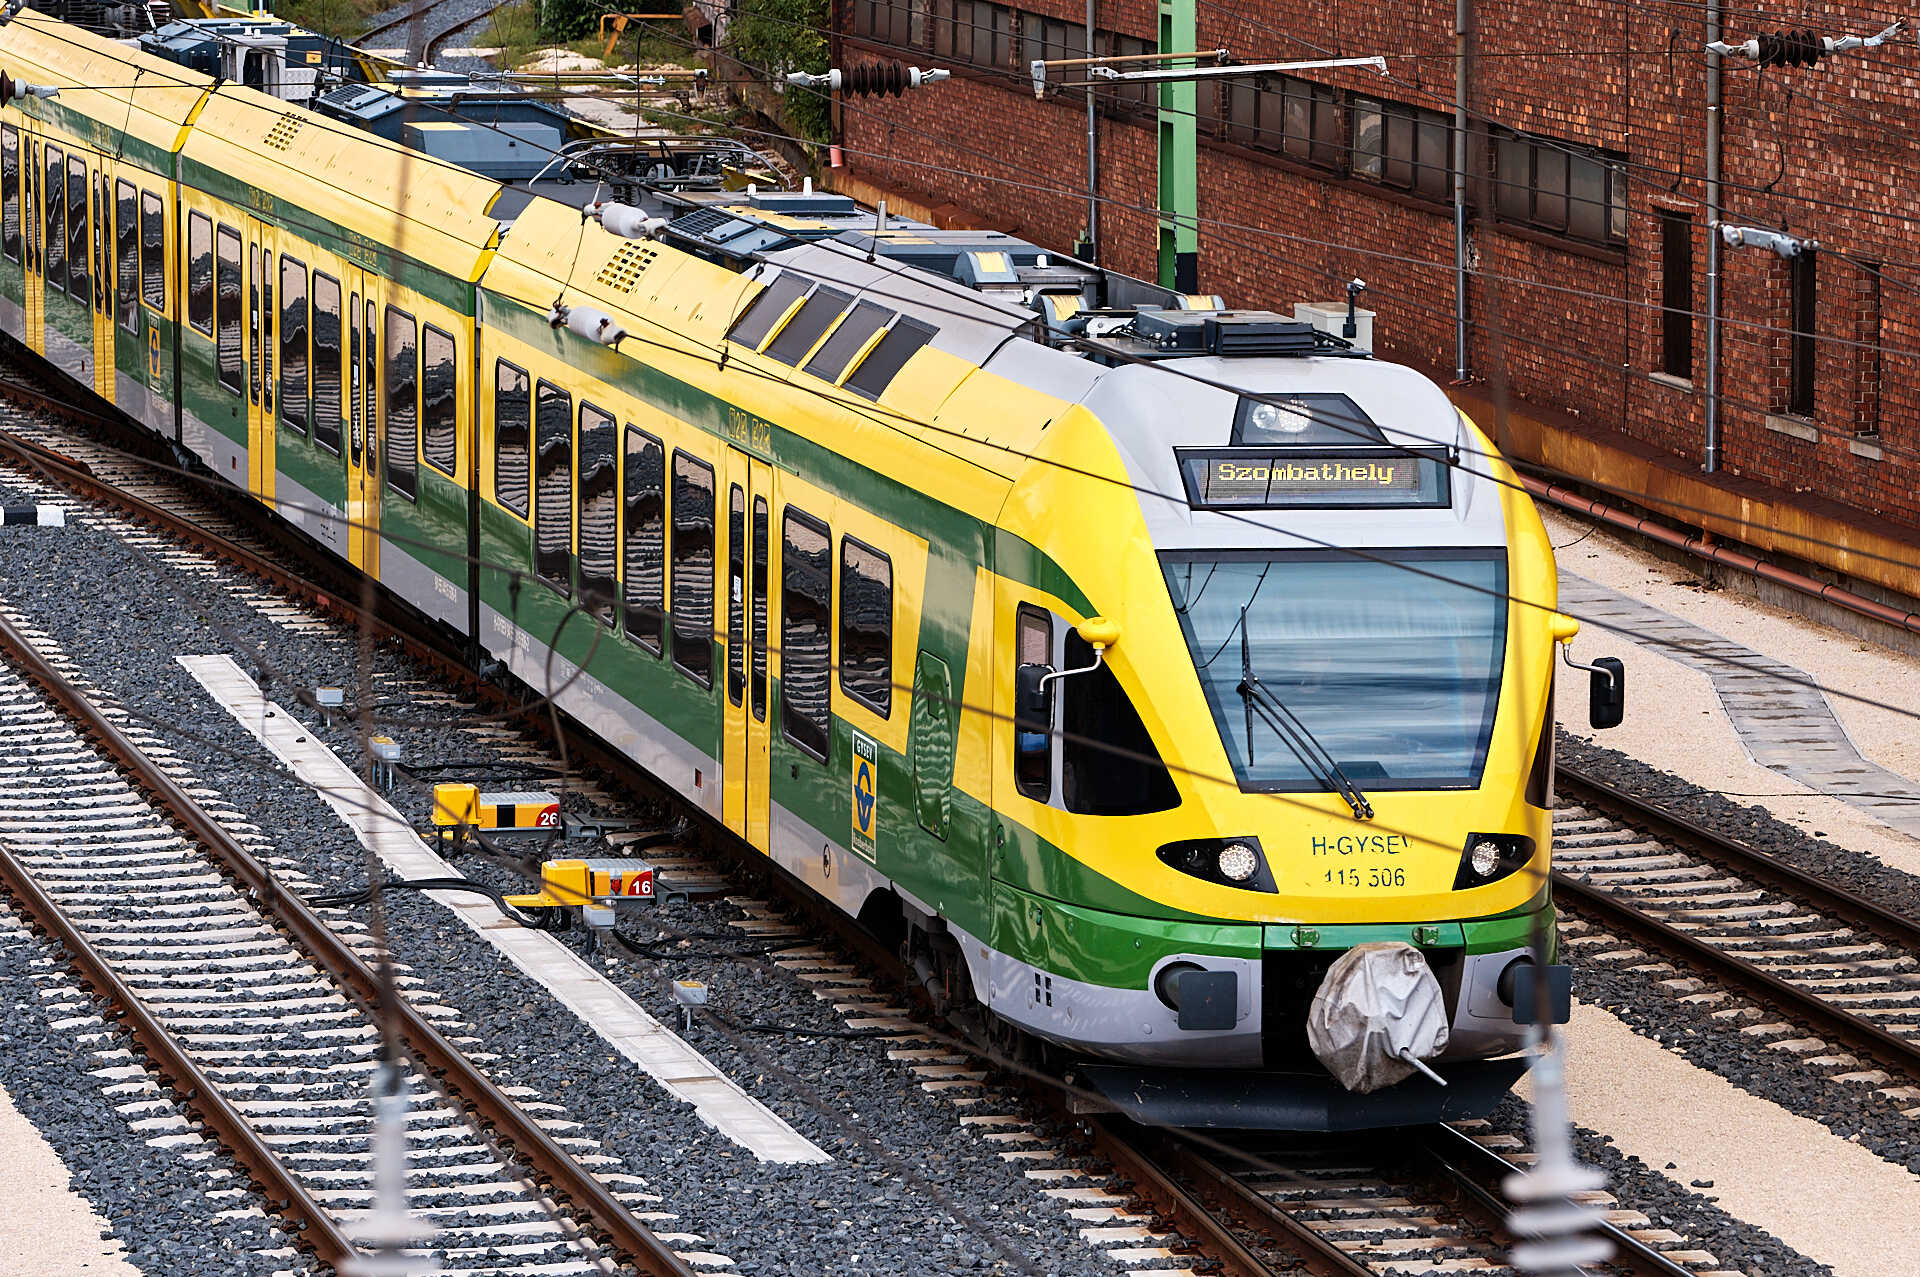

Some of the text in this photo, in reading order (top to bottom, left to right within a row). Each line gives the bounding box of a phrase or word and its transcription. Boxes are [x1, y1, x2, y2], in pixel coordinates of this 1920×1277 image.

[1218, 463, 1394, 484] Szombathely
[540, 812, 559, 826] 26
[632, 880, 651, 895] 16
